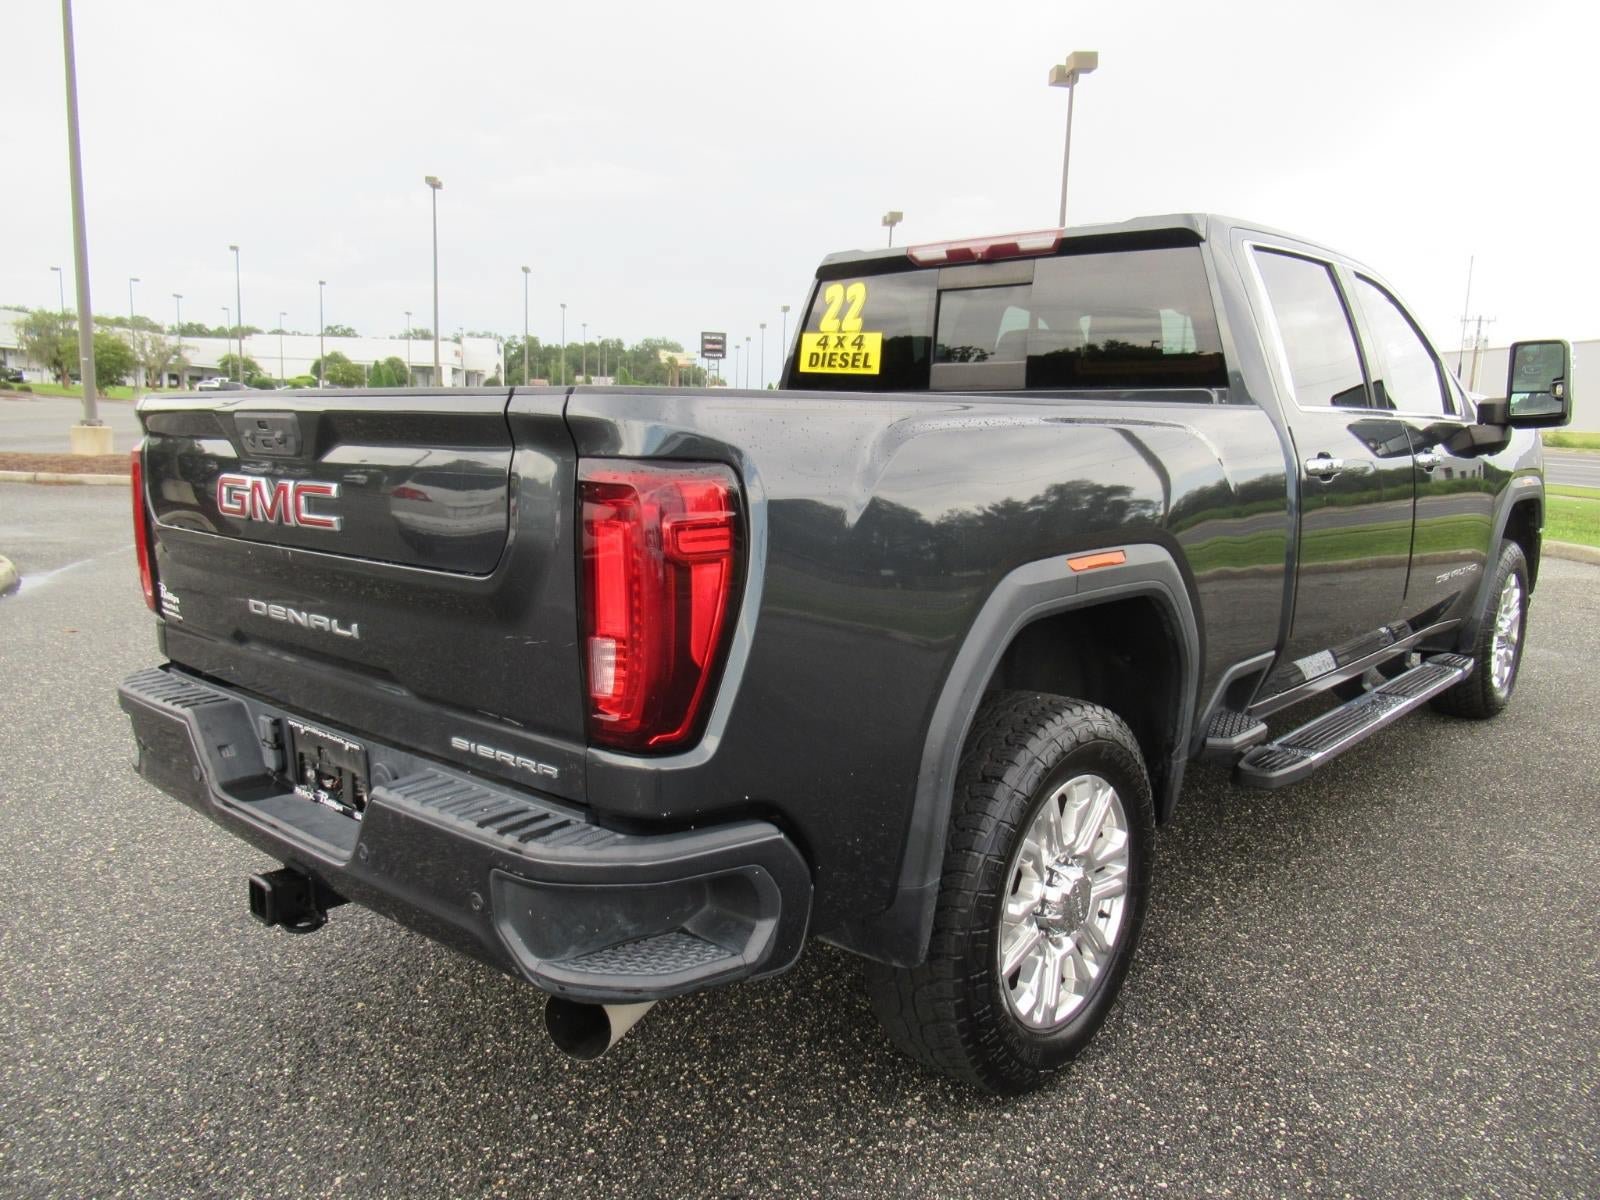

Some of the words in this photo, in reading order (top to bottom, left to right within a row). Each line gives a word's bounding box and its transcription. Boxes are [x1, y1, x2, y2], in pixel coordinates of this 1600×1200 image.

[820, 282, 867, 332] 22
[808, 351, 872, 369] DIESEL
[217, 473, 342, 532] GMC
[248, 598, 360, 640] DENALI
[451, 736, 558, 779] SIERRA
